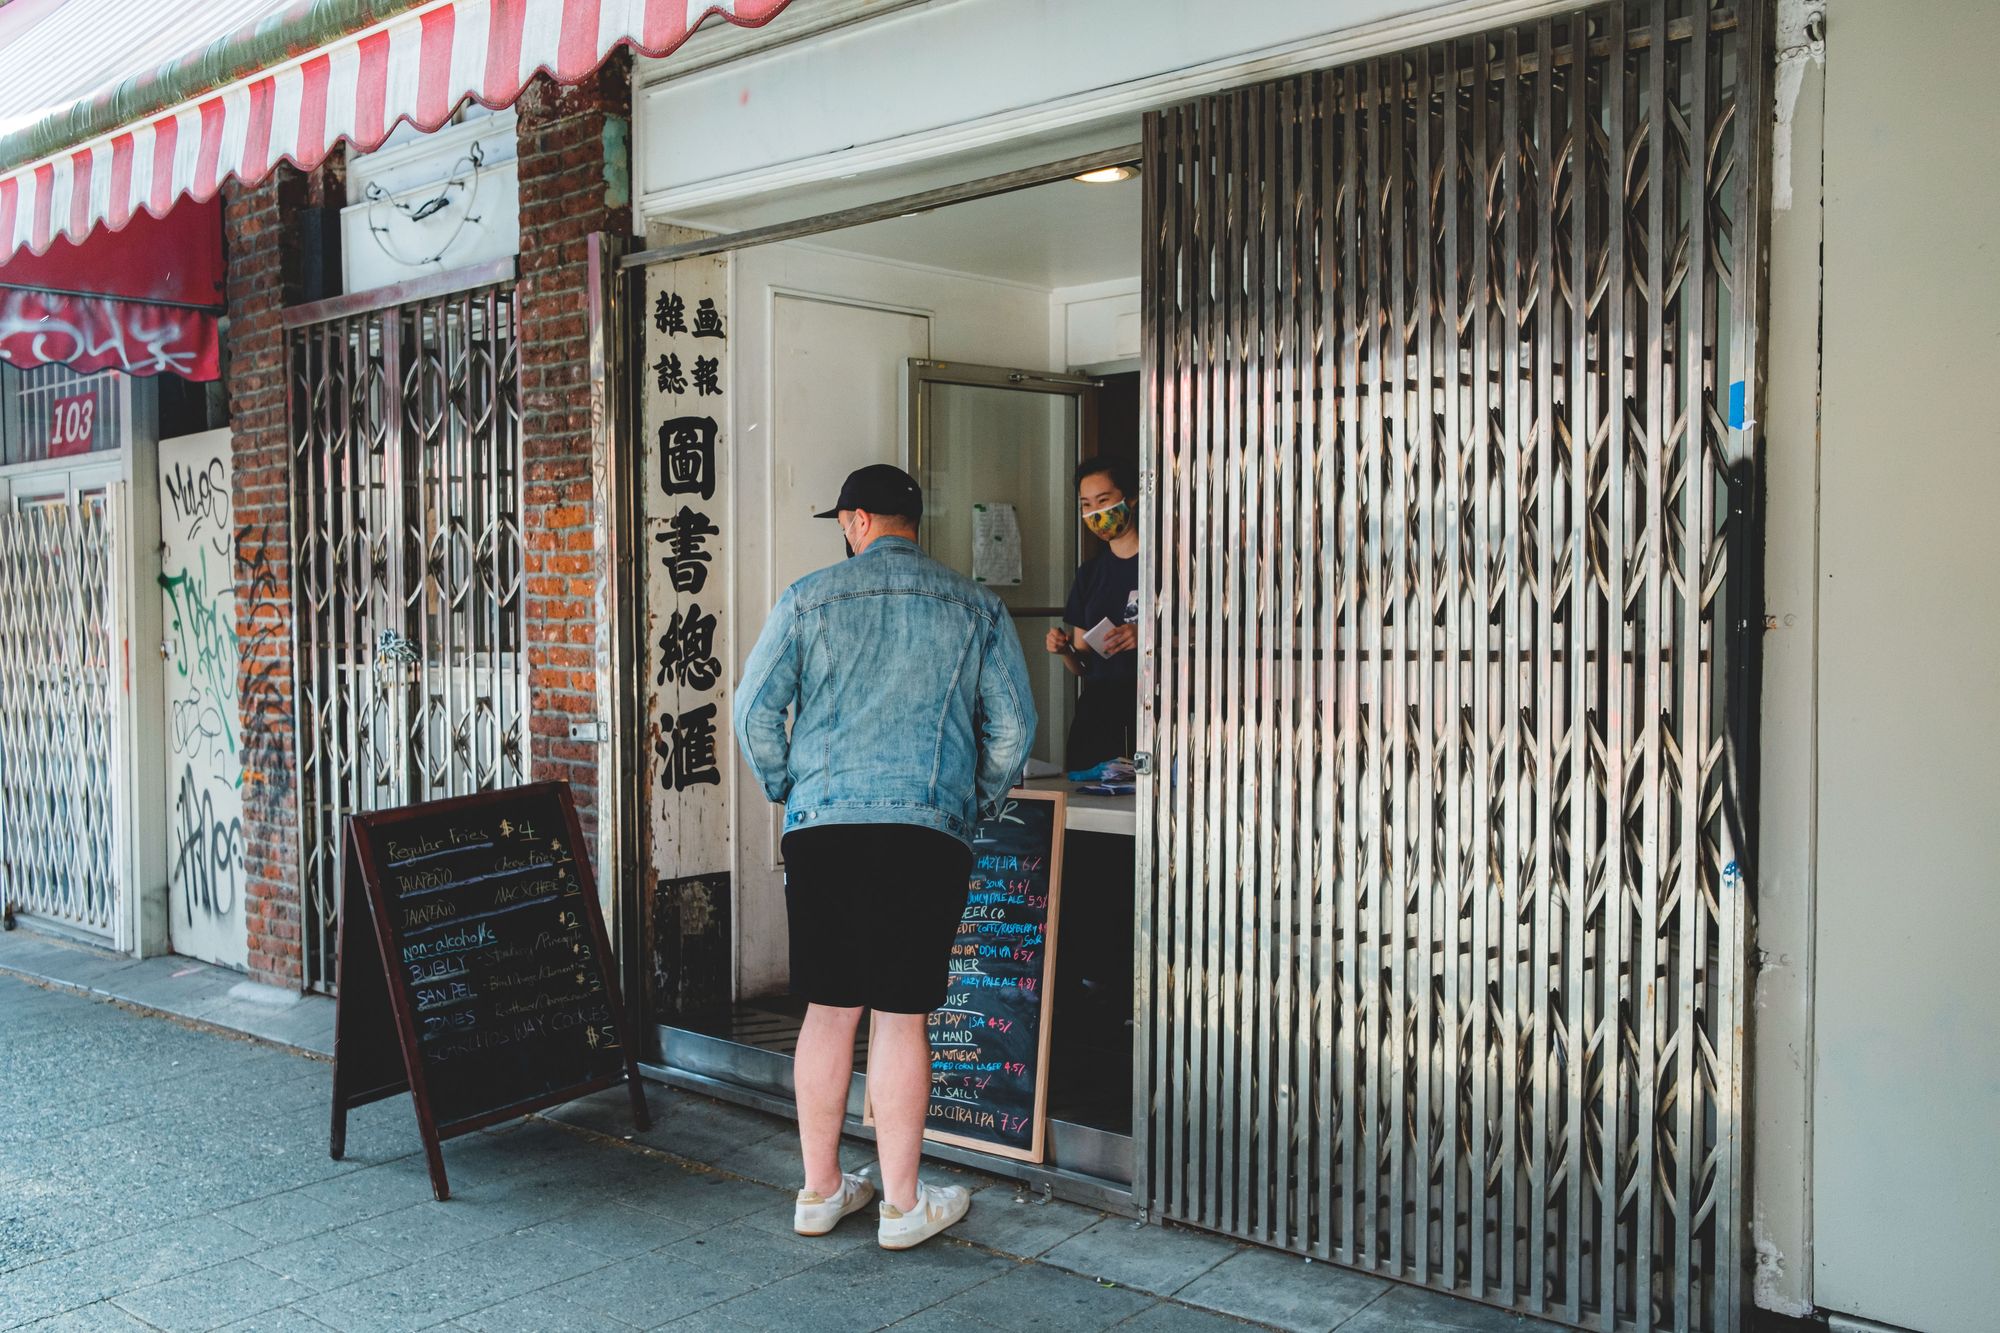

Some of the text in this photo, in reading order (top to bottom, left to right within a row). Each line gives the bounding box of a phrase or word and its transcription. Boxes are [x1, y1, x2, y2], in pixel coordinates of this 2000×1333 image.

[51, 398, 94, 445] 103
[387, 833, 444, 867] Regular
[449, 827, 489, 845] Fries
[961, 905, 988, 919] EER
[409, 956, 467, 982] BUBLY
[948, 958, 980, 972] INER
[416, 986, 448, 1009] SAN
[449, 981, 478, 1000] PEL
[927, 1011, 944, 1026] EST
[942, 1030, 973, 1043] HAND
